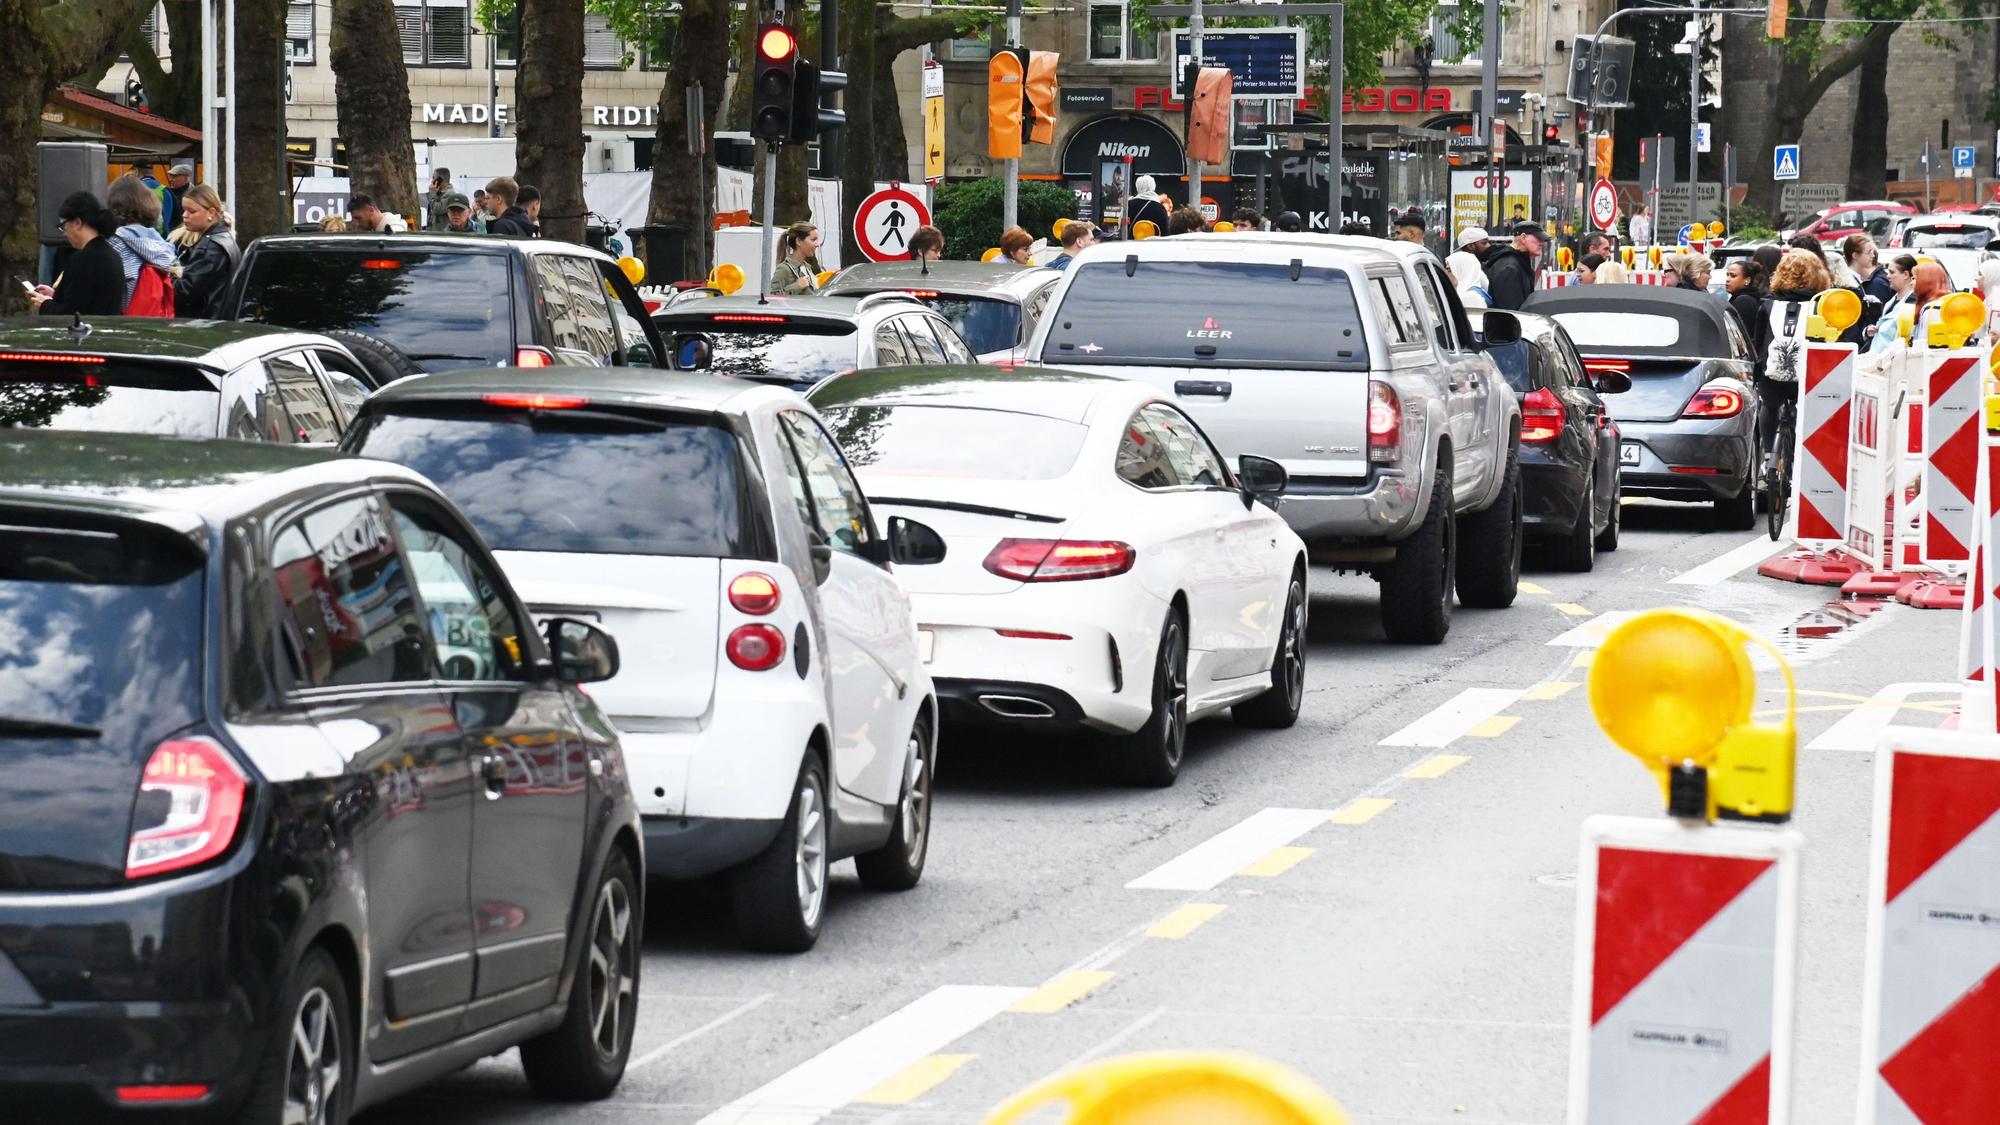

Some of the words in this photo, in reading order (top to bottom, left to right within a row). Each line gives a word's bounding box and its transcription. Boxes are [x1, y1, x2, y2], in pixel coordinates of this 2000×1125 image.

[422, 103, 508, 123] MADE
[593, 105, 659, 126] RIDI
[1097, 141, 1151, 158] Nikon
[1957, 149, 1970, 165] P
[1341, 161, 1375, 174] calable
[1785, 187, 1840, 196] Popernitsch
[1458, 199, 1488, 207] Imme
[1458, 209, 1488, 218] wiede
[1186, 329, 1233, 340] LEER
